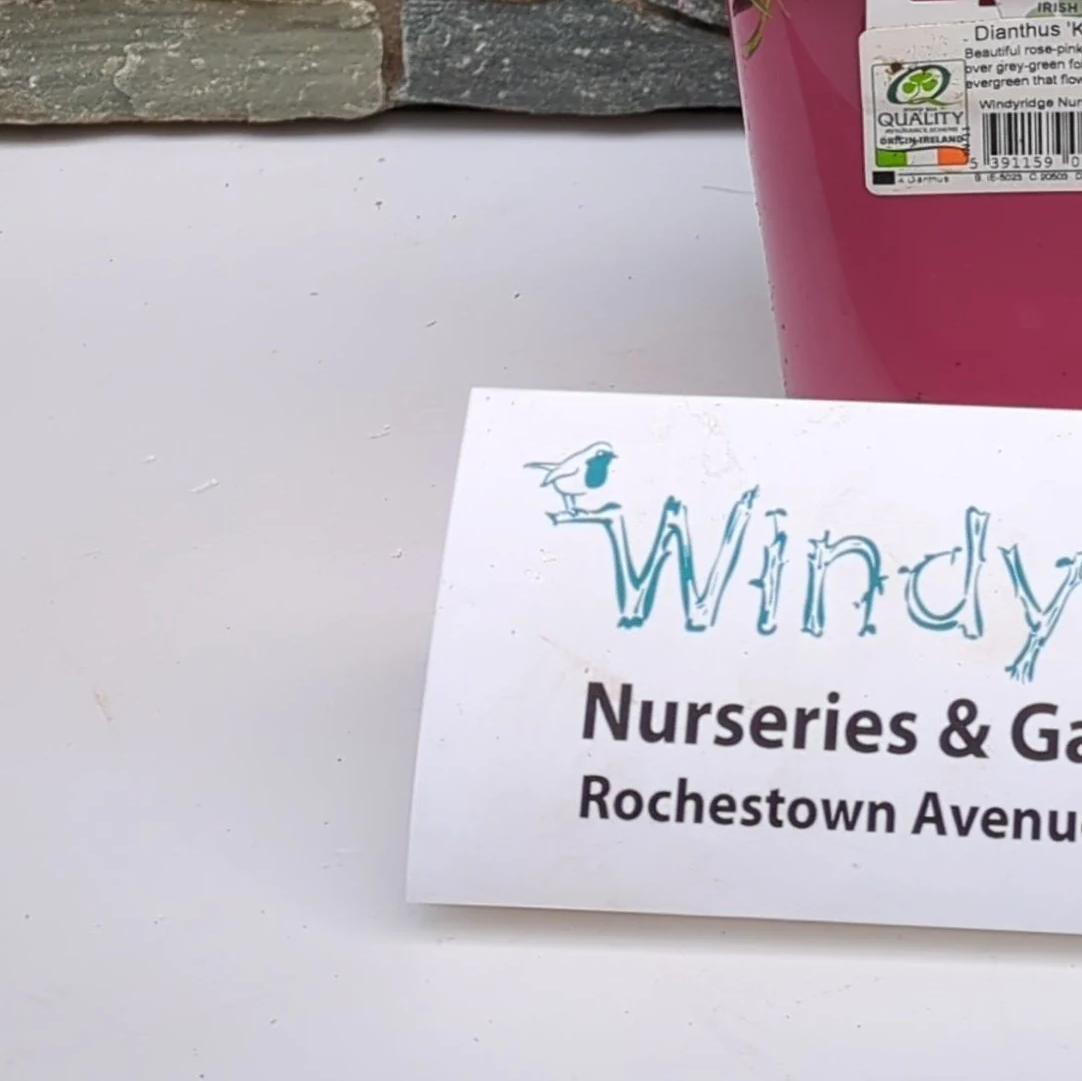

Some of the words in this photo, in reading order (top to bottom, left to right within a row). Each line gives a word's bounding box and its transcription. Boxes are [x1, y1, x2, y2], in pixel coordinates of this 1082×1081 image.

[1037, 2, 1078, 13] IRISH
[974, 23, 1061, 42] Dianthus
[964, 45, 1021, 59] Beautiful
[964, 62, 993, 74] over
[996, 59, 1066, 76] grey-green
[965, 76, 1029, 90] evergreen
[1033, 75, 1057, 86] that
[979, 97, 1054, 111] Windyridge
[878, 110, 964, 127] QUALITY
[970, 157, 978, 169] 5
[989, 156, 1053, 169] 391159
[581, 680, 918, 756] Nurseries
[938, 698, 992, 760] &
[579, 774, 896, 834] Rochestown
